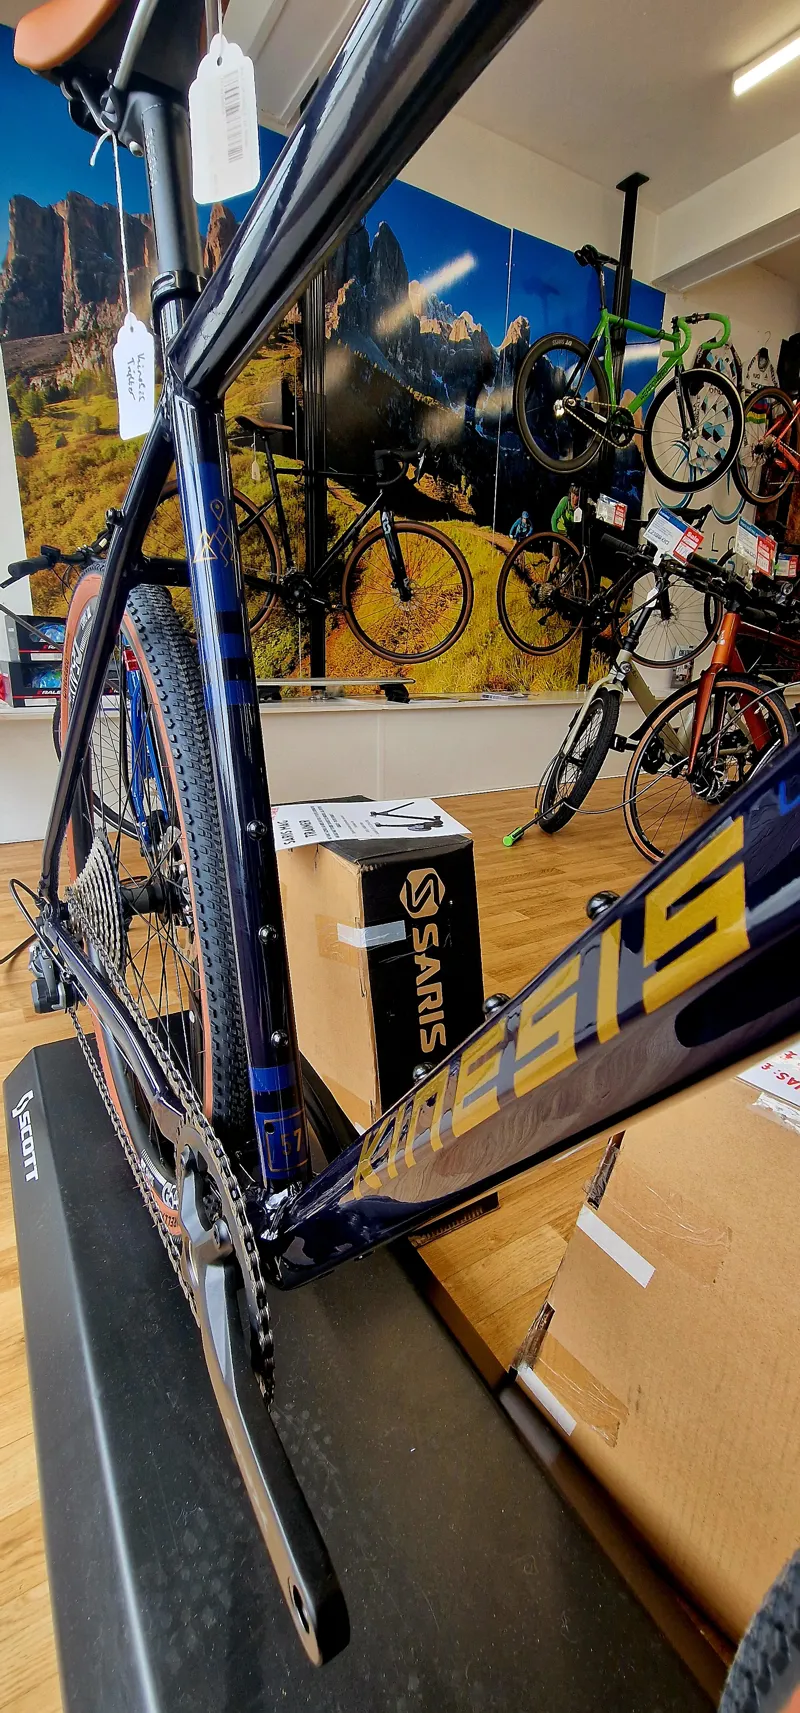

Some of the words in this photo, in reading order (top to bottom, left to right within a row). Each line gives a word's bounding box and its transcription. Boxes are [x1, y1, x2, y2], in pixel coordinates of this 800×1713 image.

[686, 530, 700, 543] Sale
[352, 816, 751, 1200] KINESIS
[412, 923, 447, 1053] SARIS
[19, 1110, 39, 1181] SCOTT
[280, 1127, 302, 1156] 57
